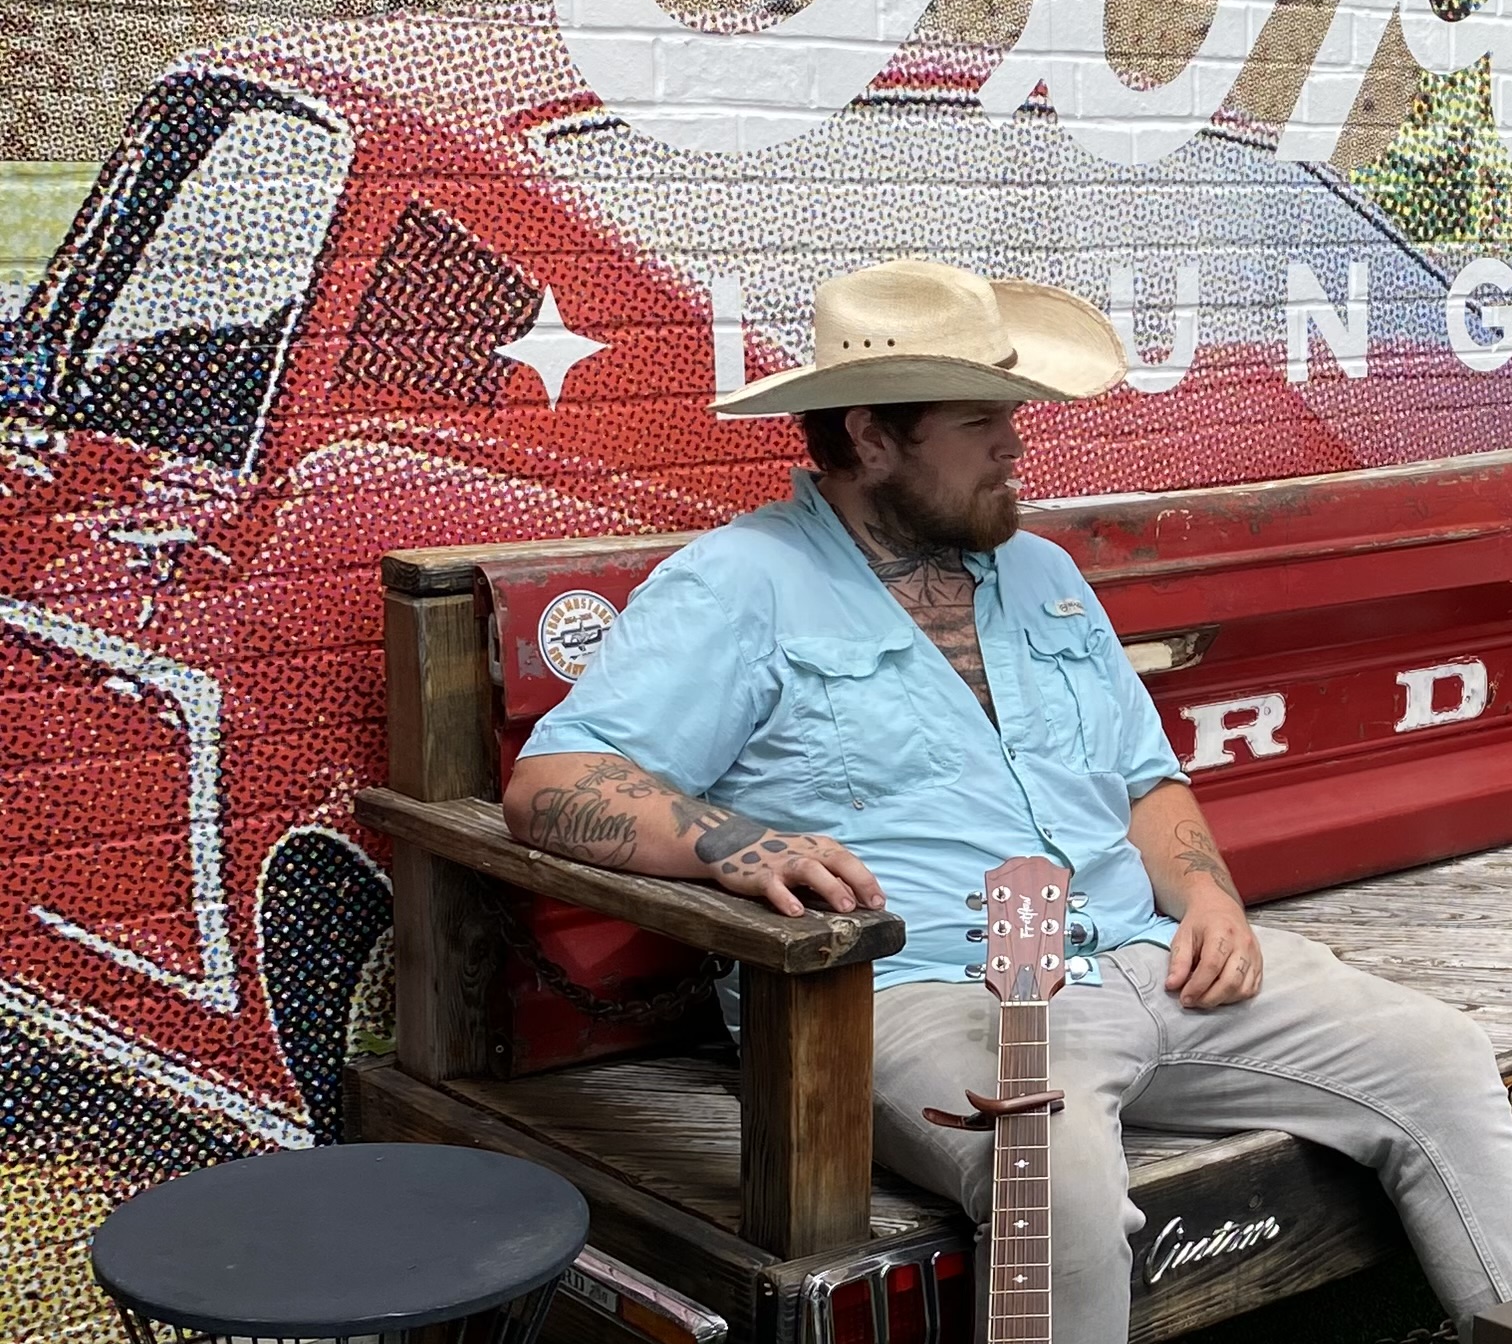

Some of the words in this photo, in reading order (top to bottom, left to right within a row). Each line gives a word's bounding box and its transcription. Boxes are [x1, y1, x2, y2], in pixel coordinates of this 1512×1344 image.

[563, 597, 613, 626] MUSTANG
[1179, 656, 1489, 772] RD
[1143, 1216, 1281, 1285] Custom
[563, 1268, 585, 1292] RD
